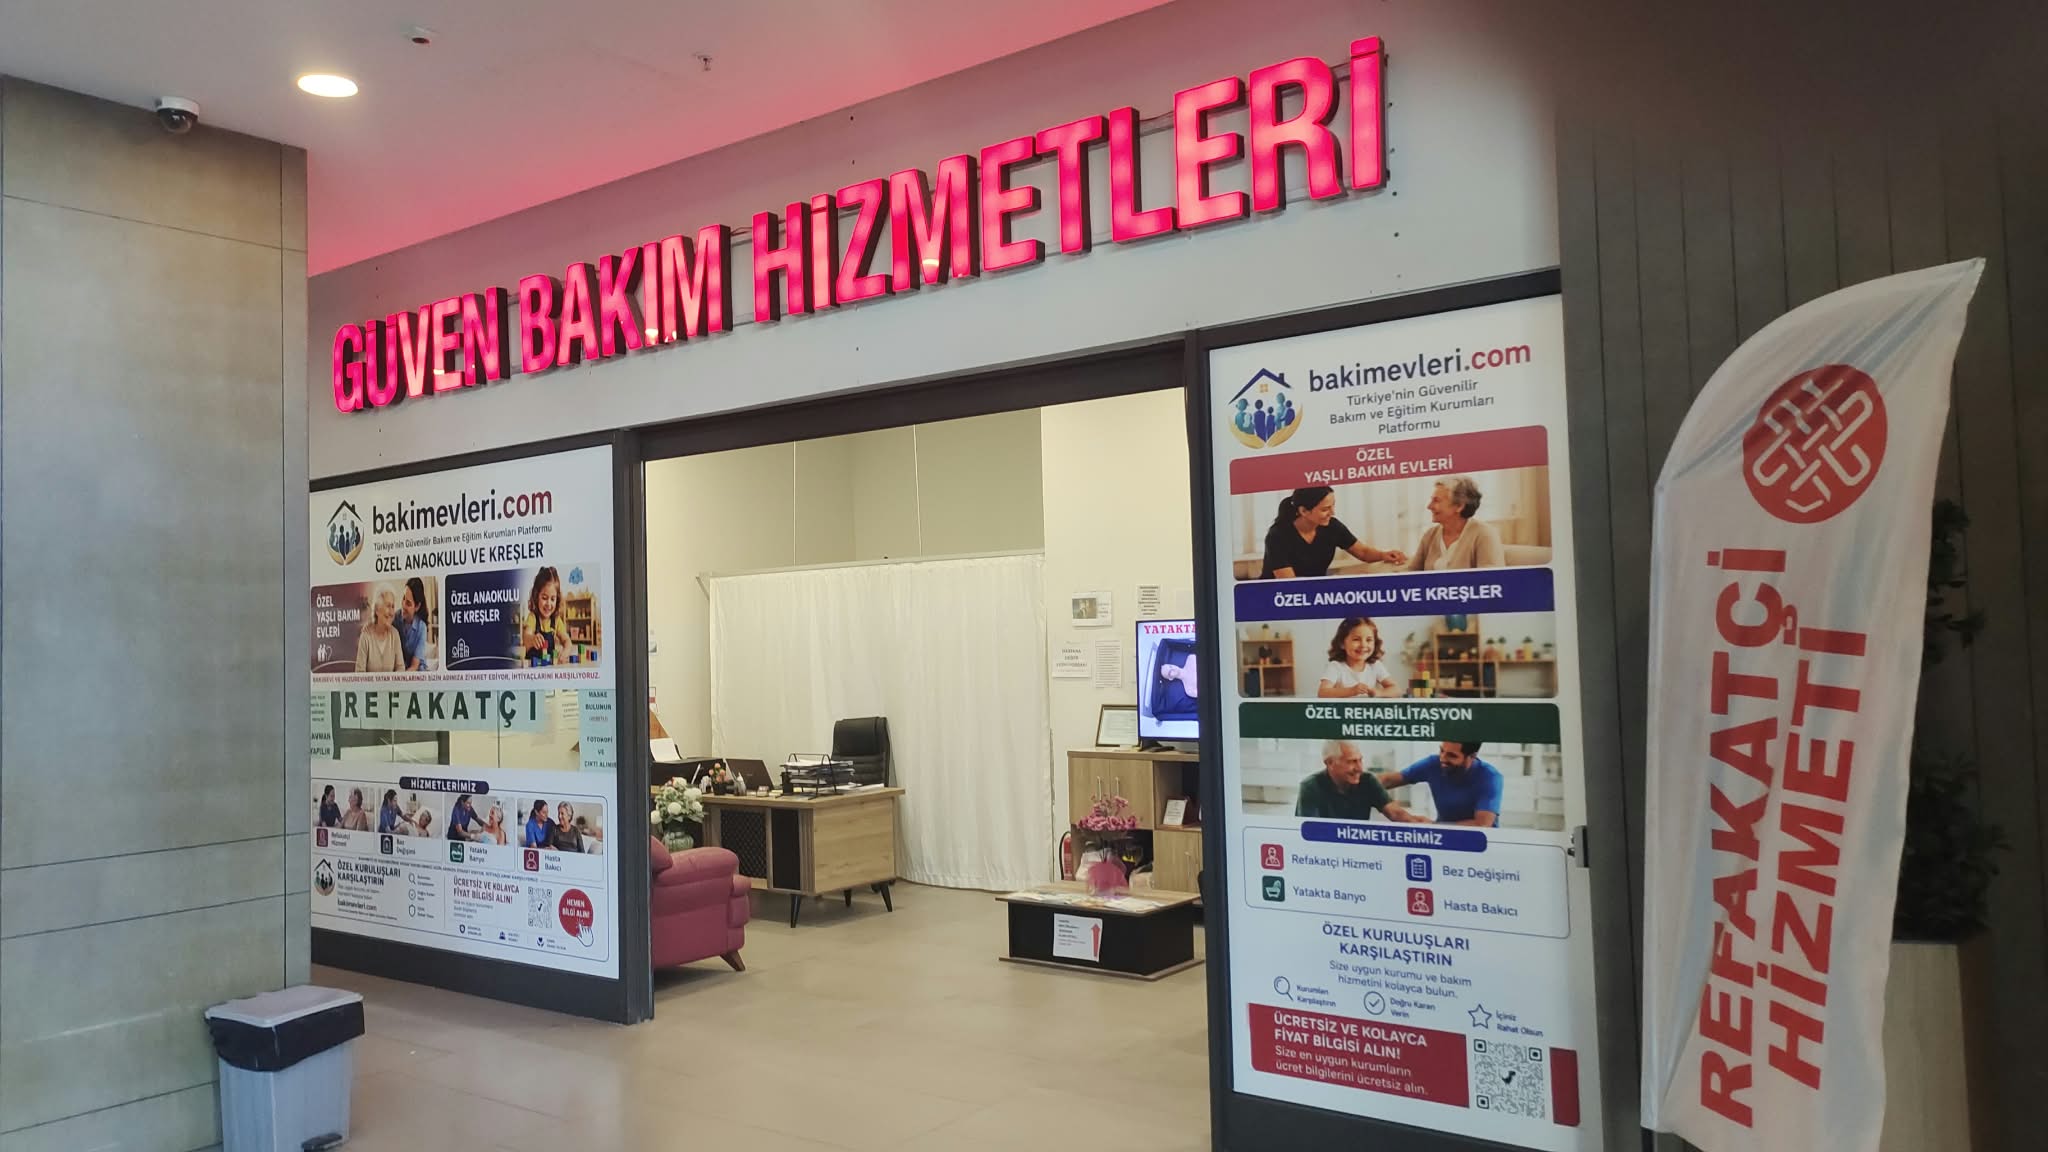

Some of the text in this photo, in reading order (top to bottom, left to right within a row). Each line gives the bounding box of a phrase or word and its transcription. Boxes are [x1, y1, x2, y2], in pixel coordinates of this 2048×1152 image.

[333, 36, 1388, 413] GÜVEN BAKIM HİZMETLERİ
[1309, 344, 1531, 393] bakimevleri.com
[1346, 379, 1479, 407] Türkiye'nin Güvenilir
[1330, 396, 1495, 425] Bakım ve Eğitim Kurumları
[1378, 419, 1441, 434] Platformu
[1356, 447, 1395, 462] ÖZEL
[1304, 454, 1454, 485] YAŞLI BAKIM EVLERİ
[373, 489, 552, 535] bakimevleri.com
[432, 535, 452, 545] Bakım
[453, 535, 461, 543] ve
[462, 531, 482, 544] Eğitim
[484, 527, 517, 540] Kurumları
[518, 524, 553, 537] Platformu
[375, 541, 544, 573] ÖZEL ANAOKULU VE KREŞLER
[316, 594, 334, 608] ÖZEL
[451, 588, 520, 606] ÖZEL ANAOKULU
[1273, 584, 1503, 607] ÖZEL ANAOKULU VE KREŞLER
[316, 609, 361, 625] YAŞLI BAKIM
[451, 608, 500, 626] VE KREŞLER
[316, 624, 341, 639] EVLERİ
[1305, 704, 1473, 722] ÖZEL REHABİLİTASYON
[1341, 723, 1436, 738] MERKEZLERİ
[411, 778, 477, 793] HİZMETLERİMİZ
[1336, 827, 1444, 846] HİZMETLERİMİZ
[1699, 548, 1798, 1129] REFAKATÇİ
[544, 854, 561, 862] Hasta
[1291, 854, 1383, 871] Refakatçi Hizmeti
[1757, 625, 1867, 1091] HİZMETİ
[337, 859, 353, 871] ÖZEL
[355, 861, 401, 878] KURULUŞLARI
[1442, 865, 1521, 883] Bez Değişimi
[337, 871, 385, 887] KARŞILAŞTIRIN
[453, 875, 483, 886] ÜCRETSİZ
[484, 880, 492, 890] VE
[493, 883, 520, 894] KOLAYCA
[453, 888, 513, 905] FİYAT BİLGİSİ ALIN!
[566, 898, 585, 908] HEMEN
[1292, 885, 1367, 904] Yatakta Banyo
[562, 907, 576, 917] BİLGİ
[1443, 900, 1519, 917] Hasta Bakıcı
[1322, 920, 1470, 951] ÖZEL KURULUŞLARI
[1339, 942, 1453, 967] KARŞILAŞTIRIN
[1329, 959, 1472, 988] Size uygun kurumu ve bakım
[1337, 974, 1459, 999] hizmetini kolayca bulun.
[1389, 996, 1413, 1009] Doğru
[1390, 1009, 1410, 1019] Verin
[1496, 1009, 1517, 1022] İçiniz
[1273, 1010, 1428, 1048] ÜCRETSİZ VE KOLAYCA
[1496, 1022, 1544, 1038] Rahat Olsun
[1274, 1027, 1401, 1060] FİYAT BİLGİSİ ALIN!
[1275, 1045, 1297, 1058] Size
[1299, 1049, 1313, 1060] en
[1315, 1053, 1349, 1068] uygun
[1276, 1059, 1303, 1073] ücret
[1305, 1064, 1355, 1082] bilgilerini
[1357, 1073, 1402, 1091] ücretsiz
